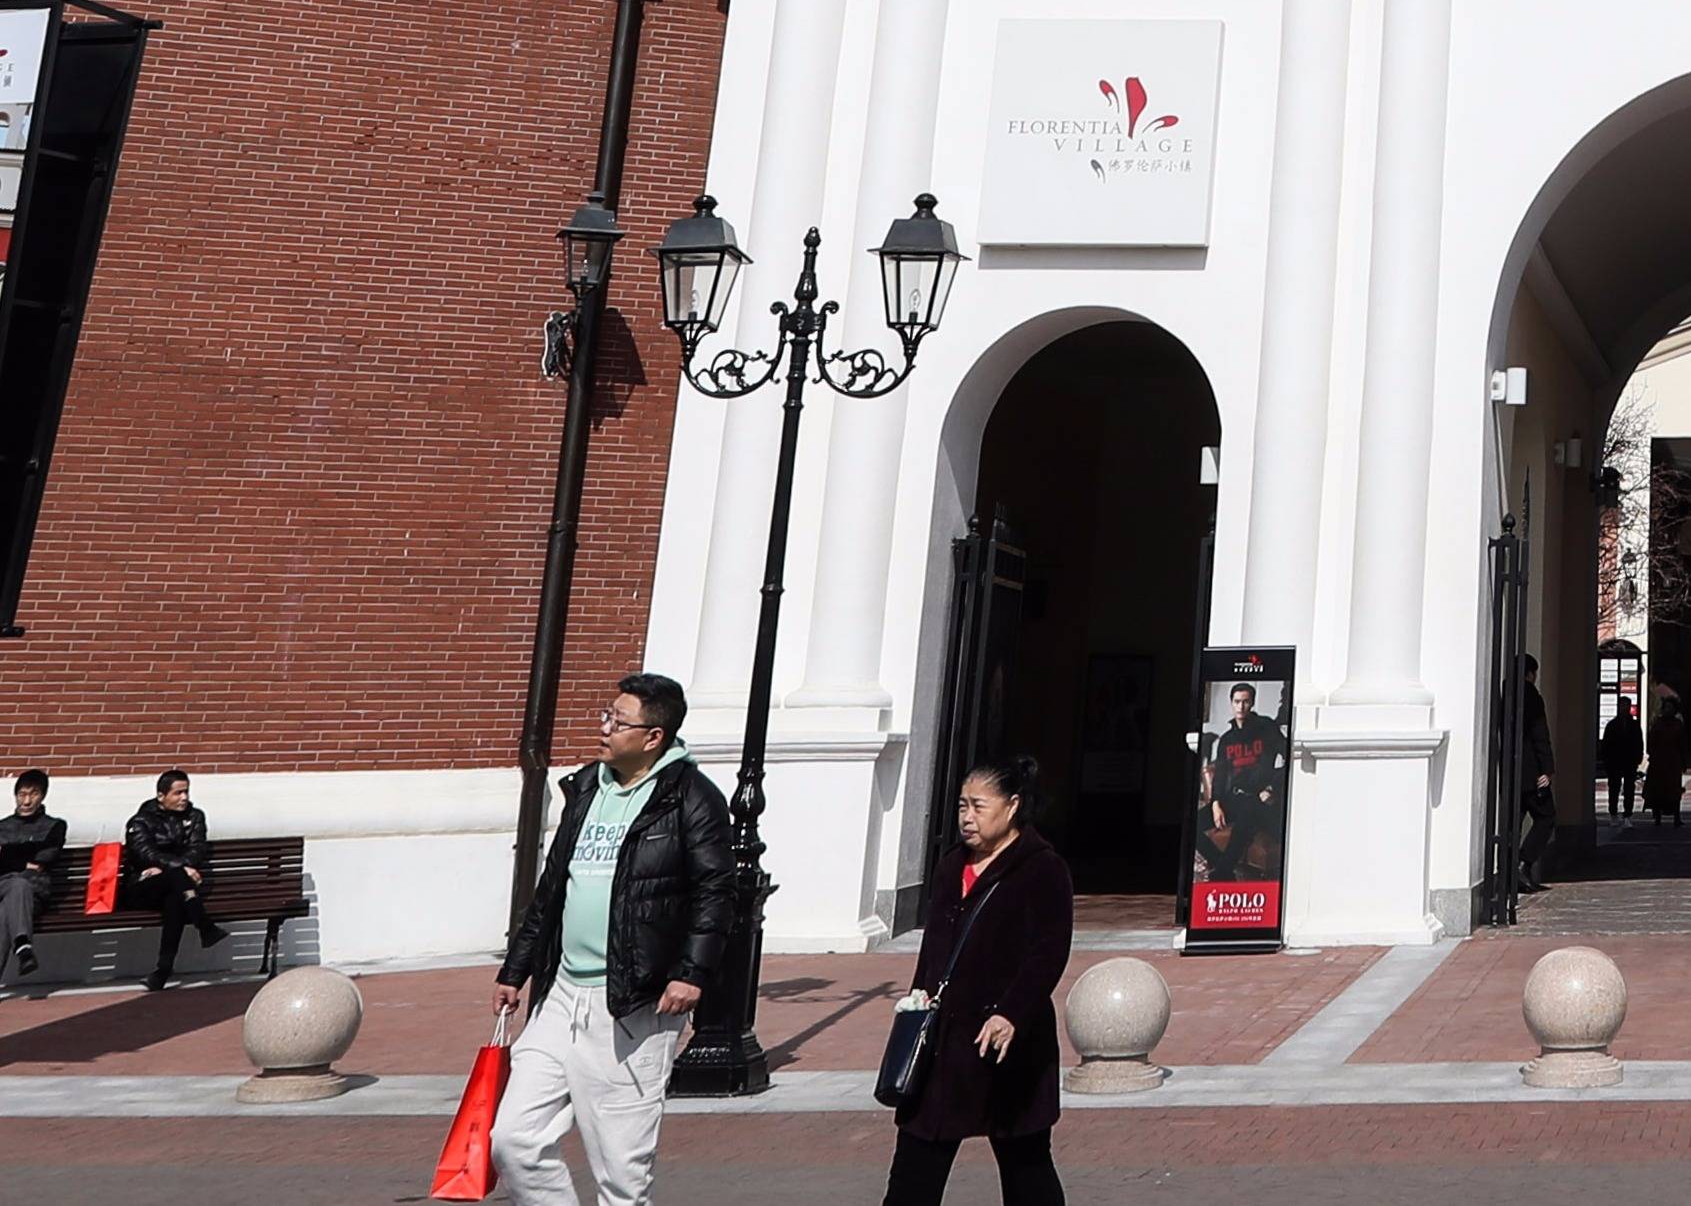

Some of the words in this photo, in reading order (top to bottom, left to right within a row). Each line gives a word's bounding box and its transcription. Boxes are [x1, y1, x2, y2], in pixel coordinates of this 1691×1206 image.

[1007, 120, 1123, 135] FLORENTIA
[1053, 138, 1193, 153] VILLAGE
[1107, 158, 1193, 173] 佛罗伦萨小镇
[1226, 739, 1264, 759] POLO
[582, 820, 626, 846] keep
[1218, 892, 1266, 909] POLO
